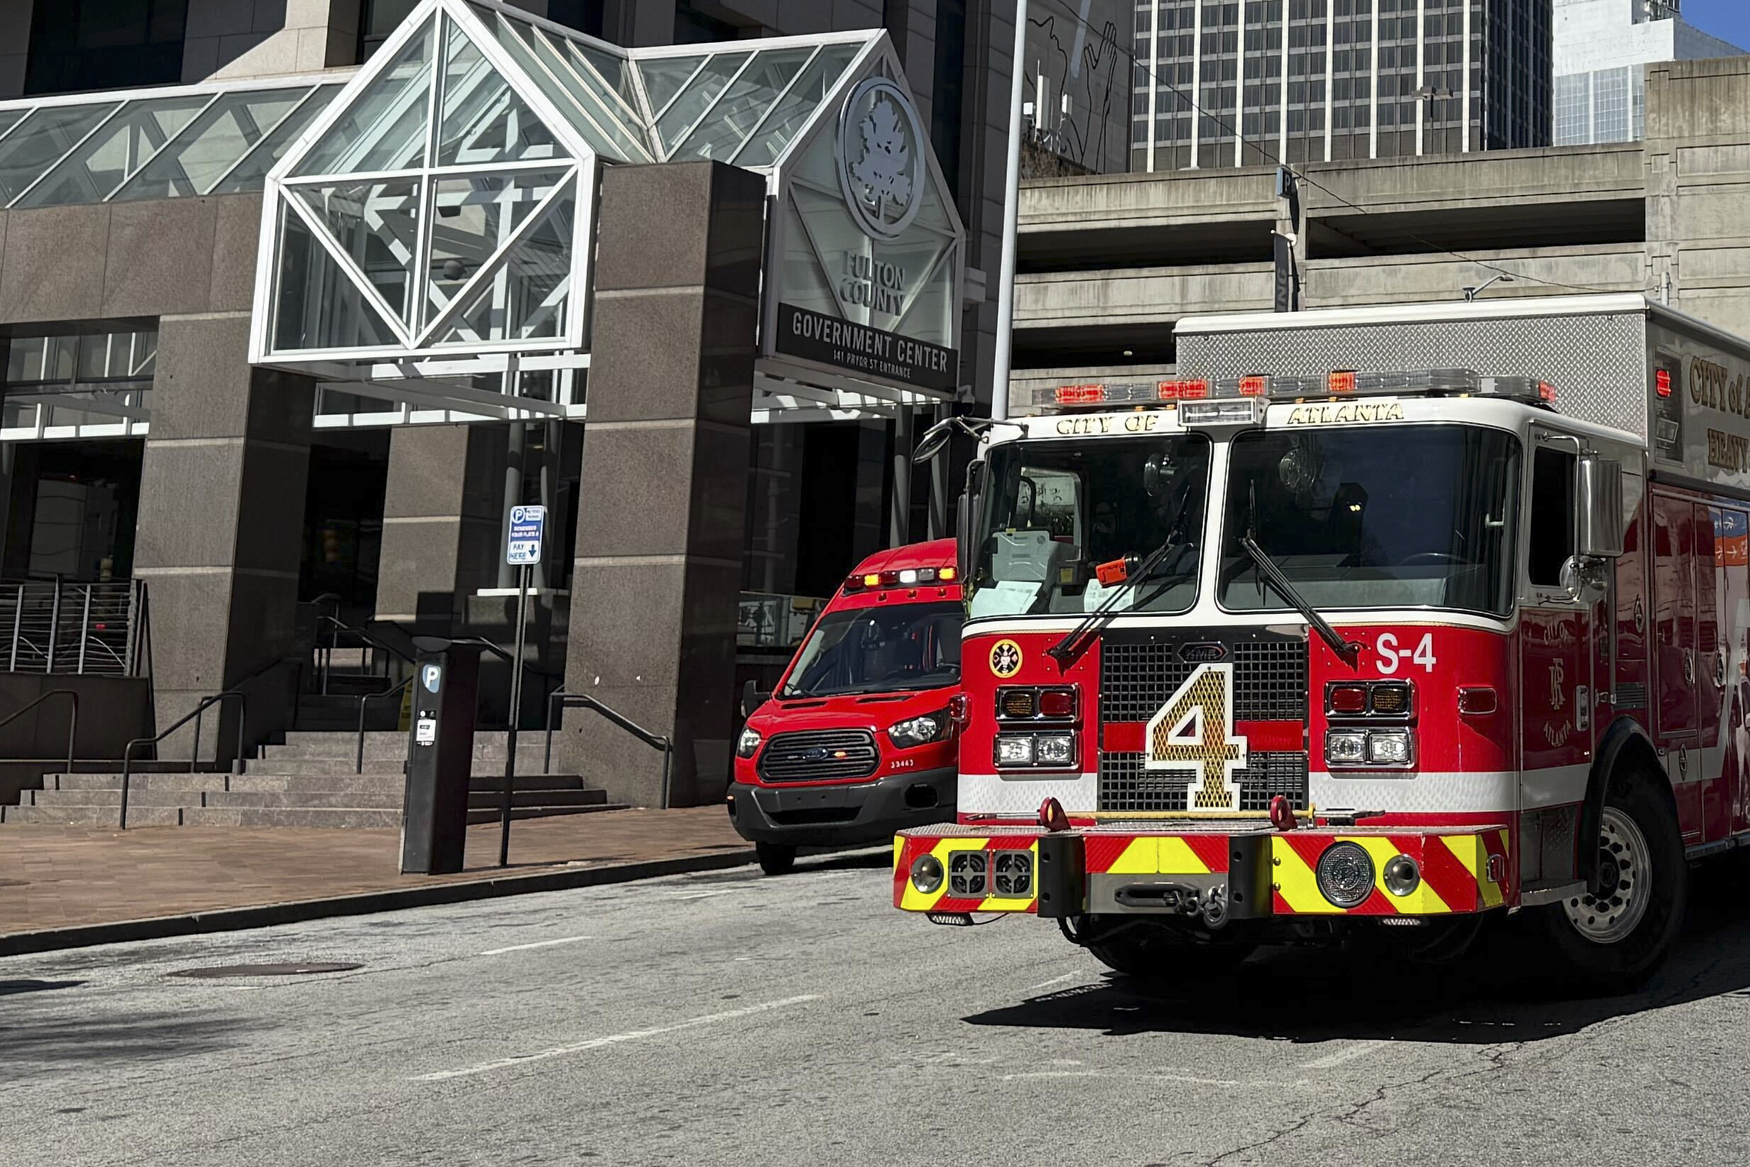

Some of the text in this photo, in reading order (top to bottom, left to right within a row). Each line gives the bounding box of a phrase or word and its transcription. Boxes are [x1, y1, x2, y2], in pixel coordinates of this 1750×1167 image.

[843, 250, 906, 291] FULTON
[840, 277, 907, 317] COUNTY
[792, 311, 948, 373] GOVERNMENT CENTER
[833, 349, 911, 379] 141 PRYOR ST ENTRANCE
[1690, 355, 1728, 412] CITY
[1728, 372, 1743, 416] of
[1056, 403, 1405, 435] CITY OF ATLANTA
[1707, 427, 1749, 474] HEAVY
[514, 509, 524, 521] P
[1375, 632, 1437, 675] S-4
[426, 667, 439, 688] P
[1145, 662, 1248, 812] 4
